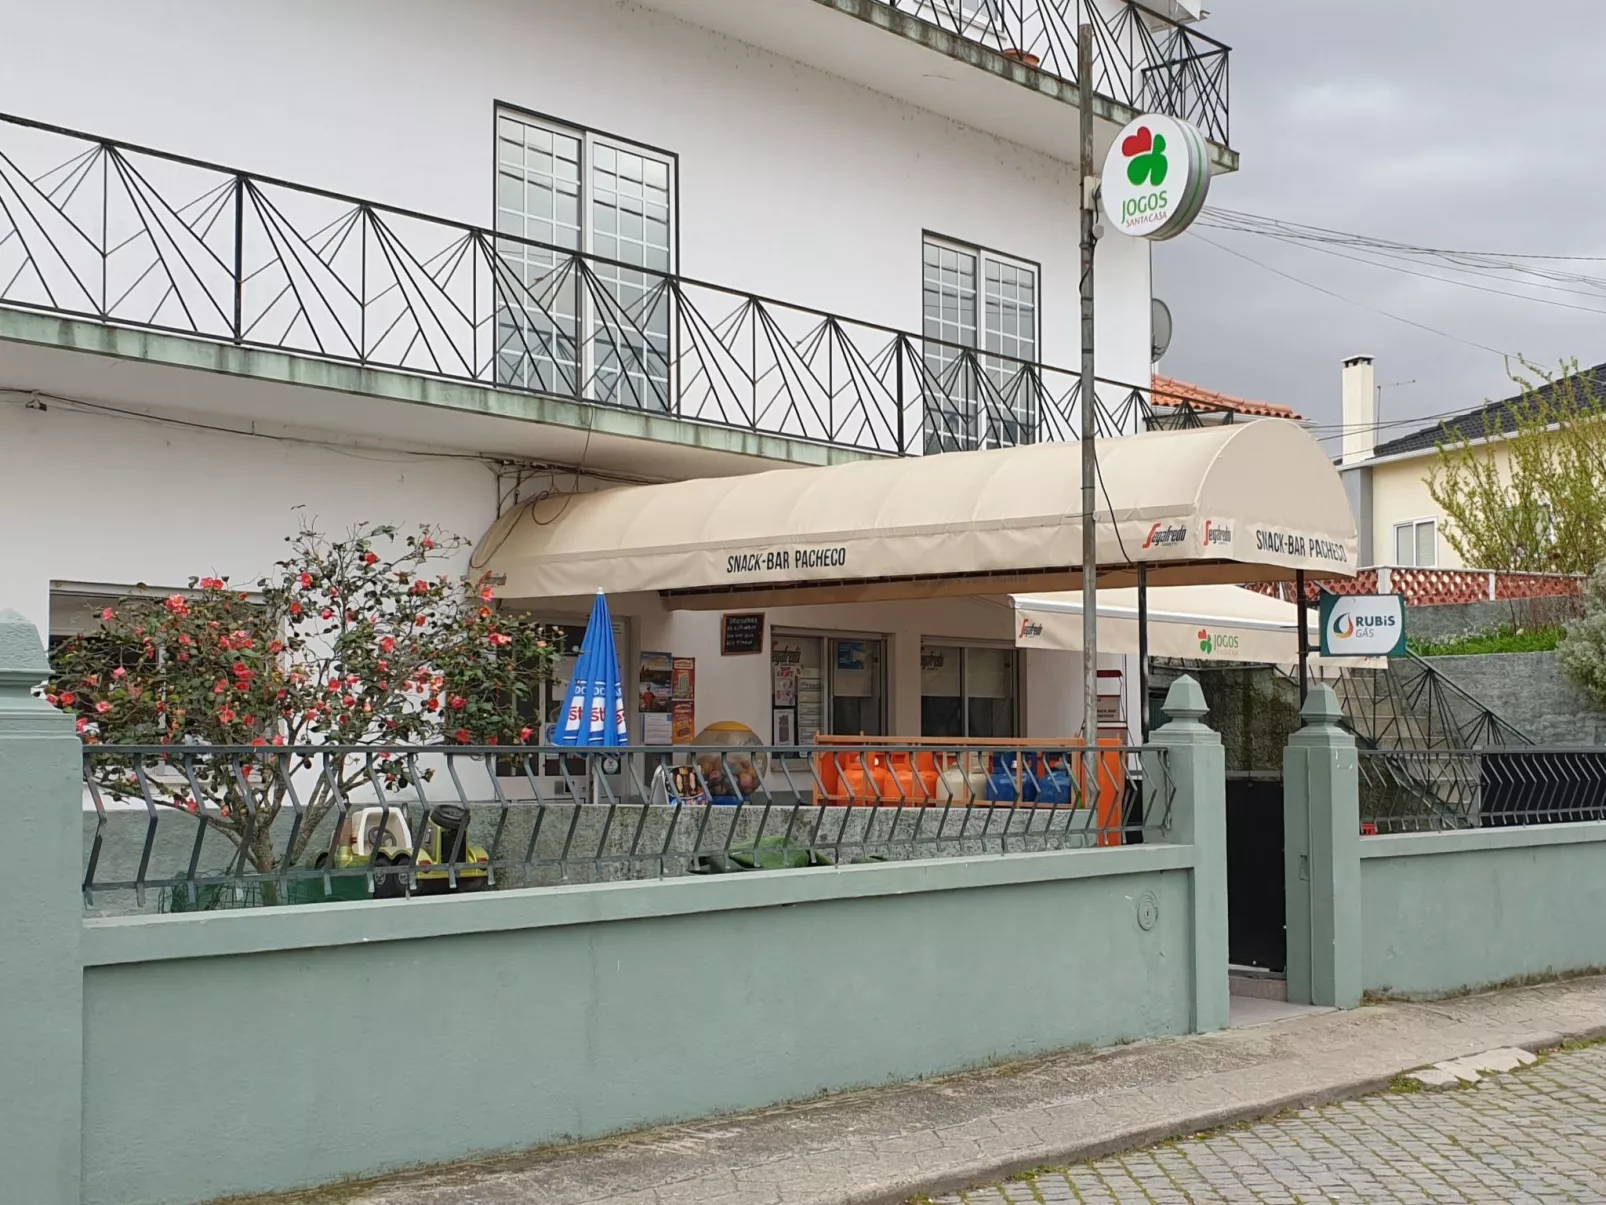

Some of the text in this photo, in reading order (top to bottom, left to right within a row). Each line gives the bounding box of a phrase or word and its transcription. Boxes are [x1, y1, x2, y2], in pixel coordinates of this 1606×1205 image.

[1121, 190, 1168, 224] JOGOS
[1142, 523, 1187, 548] Segafredo
[1256, 529, 1347, 562] SNACK-BAR PACHECO
[726, 547, 846, 573] SNACK-BAR PACHECO
[1213, 634, 1239, 651] JOGOS
